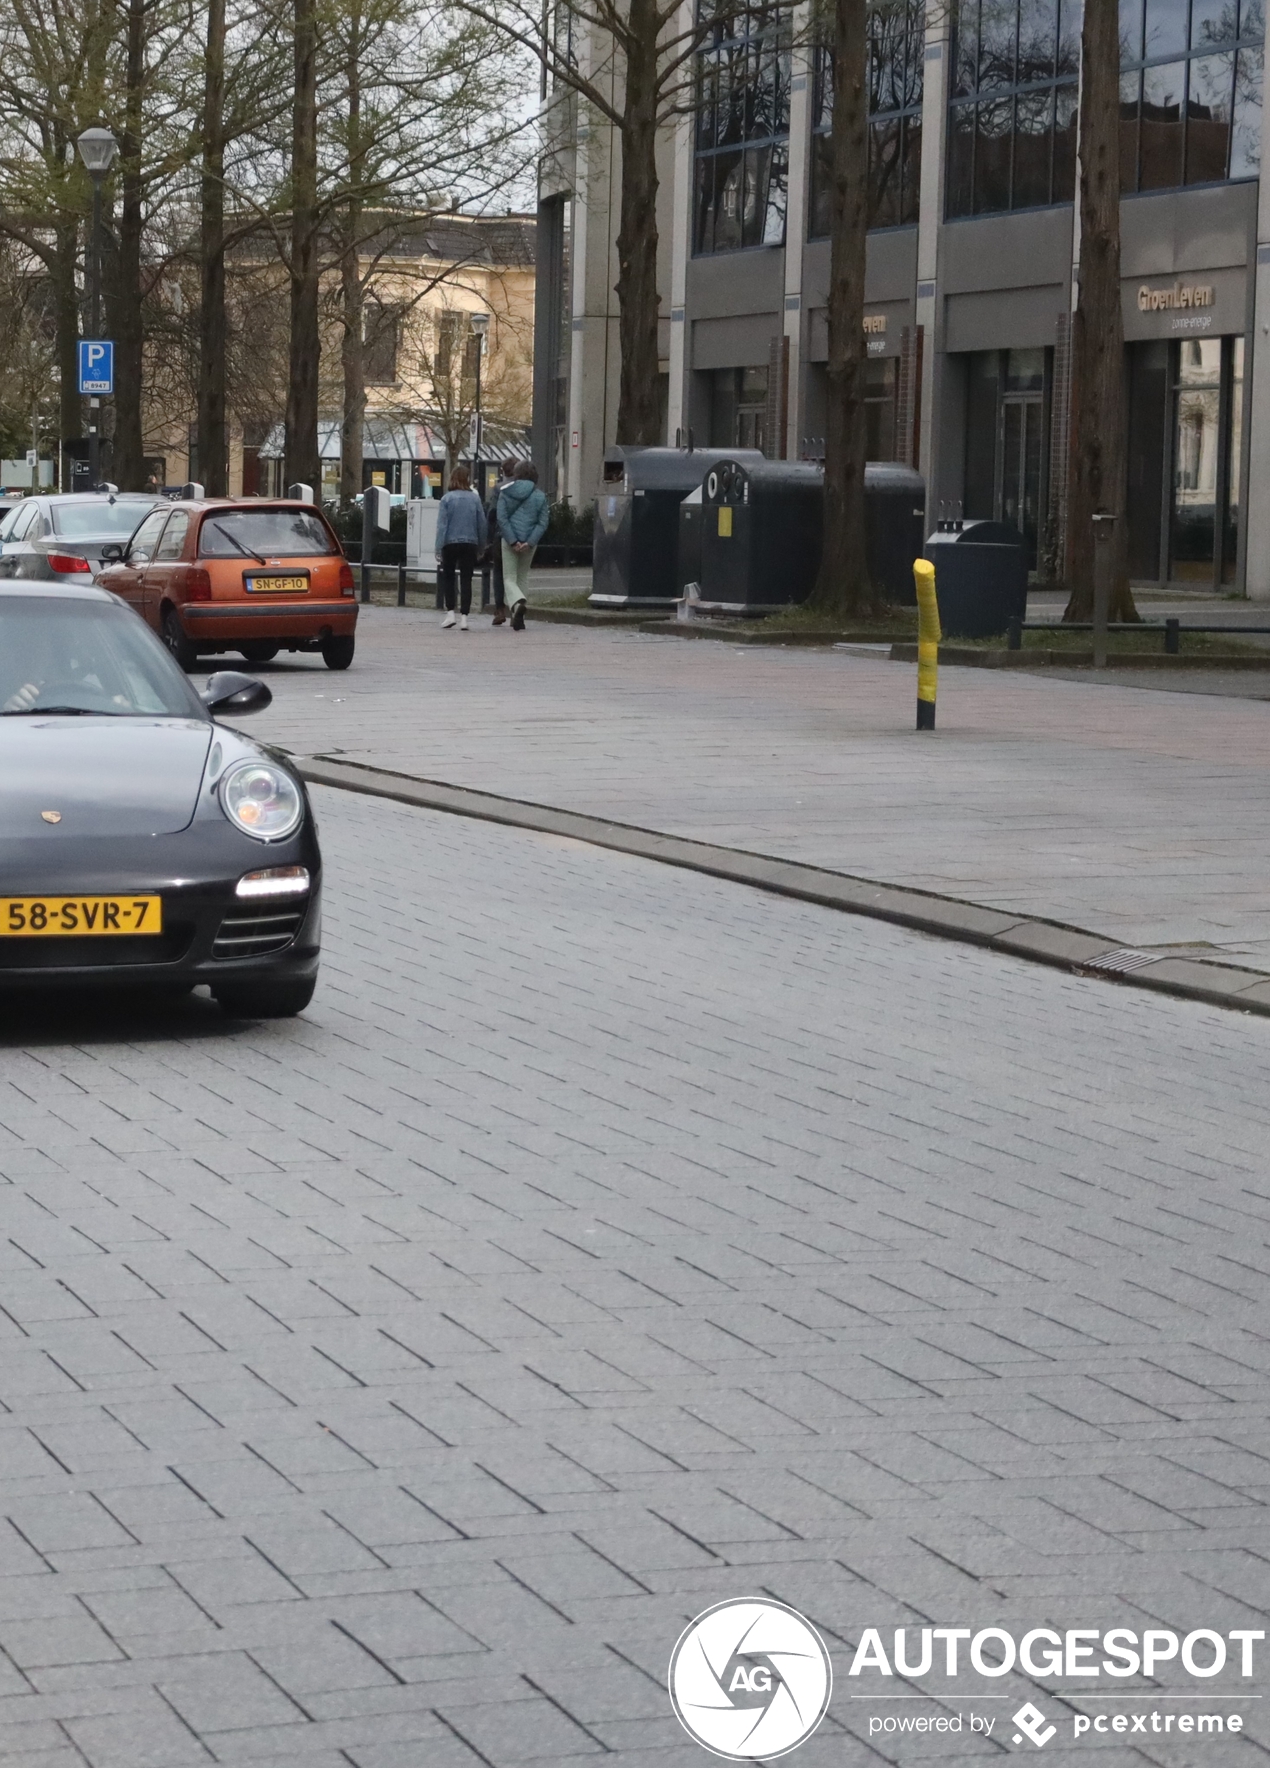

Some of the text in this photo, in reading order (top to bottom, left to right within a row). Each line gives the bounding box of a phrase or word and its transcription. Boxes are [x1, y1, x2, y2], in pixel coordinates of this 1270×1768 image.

[1137, 282, 1213, 311] GroenLeven
[862, 315, 886, 333] even
[88, 344, 105, 368] P
[256, 578, 303, 590] SN-GF-10
[8, 901, 150, 930] 58-SVR-7
